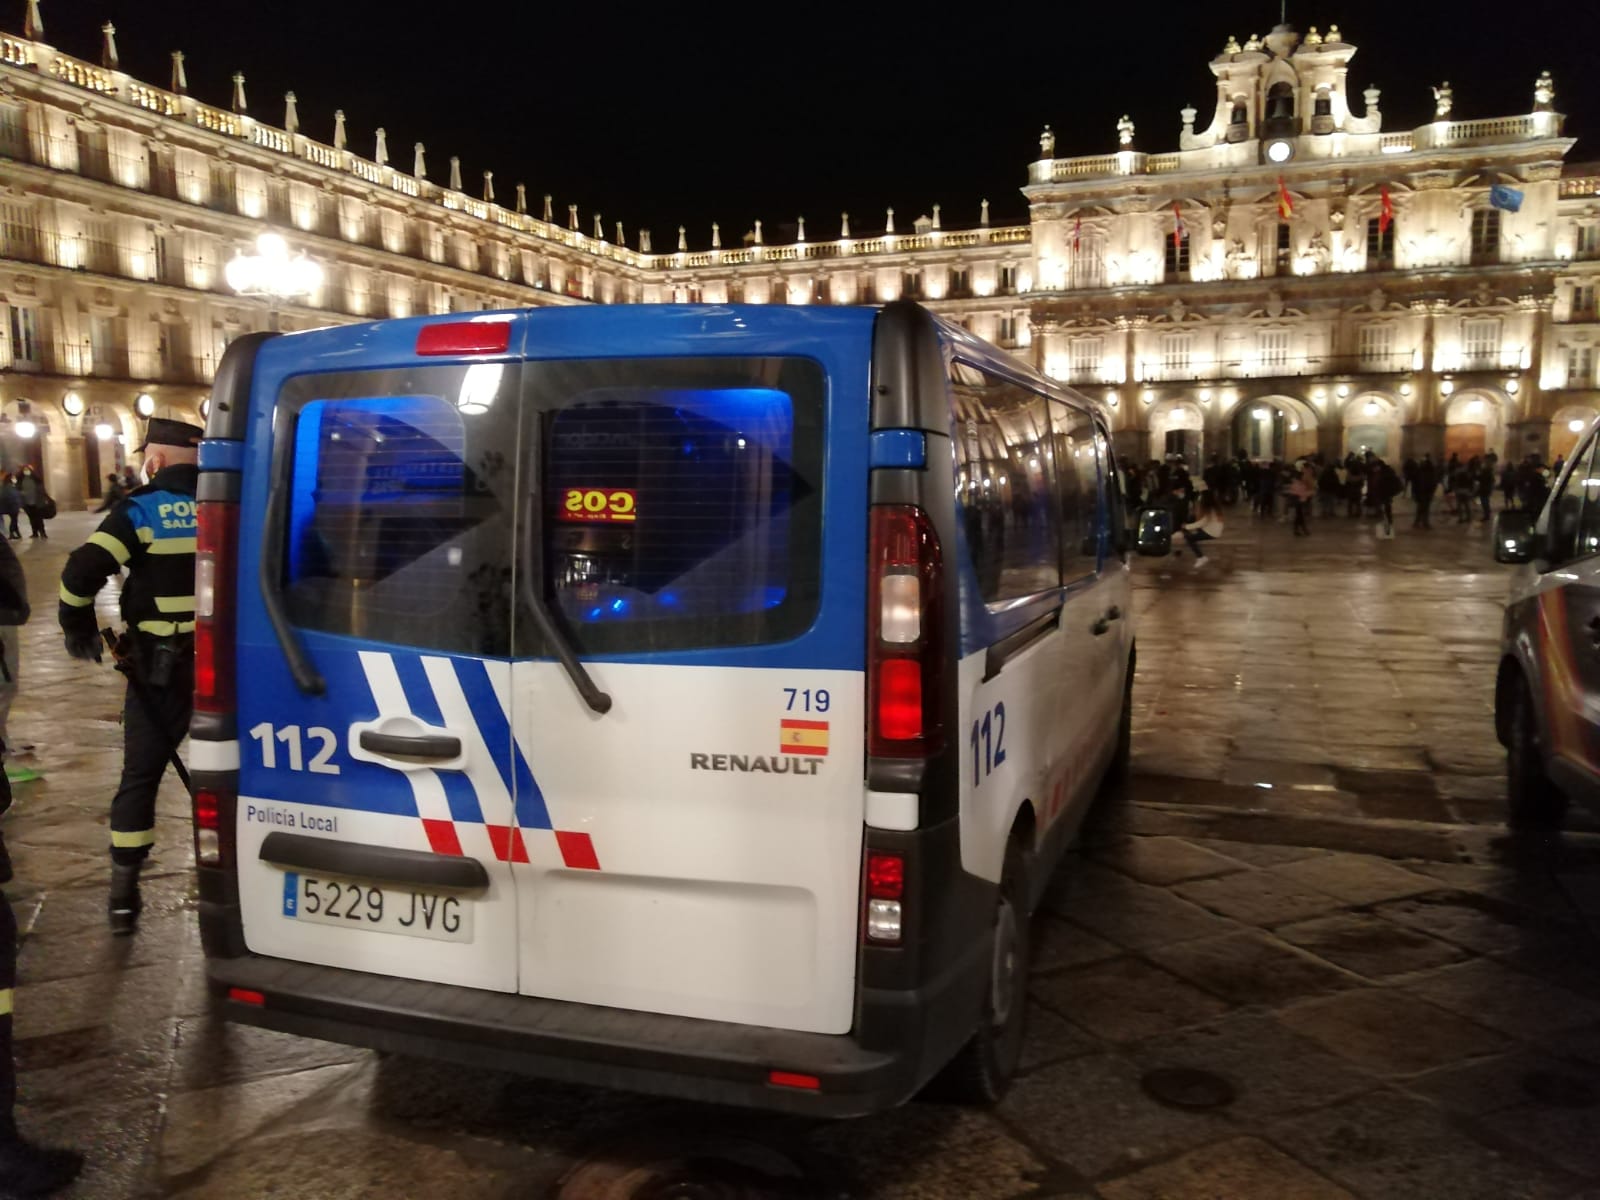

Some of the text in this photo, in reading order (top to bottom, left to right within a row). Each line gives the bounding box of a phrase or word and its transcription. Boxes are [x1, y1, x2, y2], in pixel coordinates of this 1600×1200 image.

[783, 687, 830, 713] 719
[249, 722, 341, 775] 112
[690, 752, 824, 776] RENAULT
[971, 701, 1006, 788] 112
[247, 805, 338, 832] Policía Local
[304, 878, 461, 933] 5229 JVG
